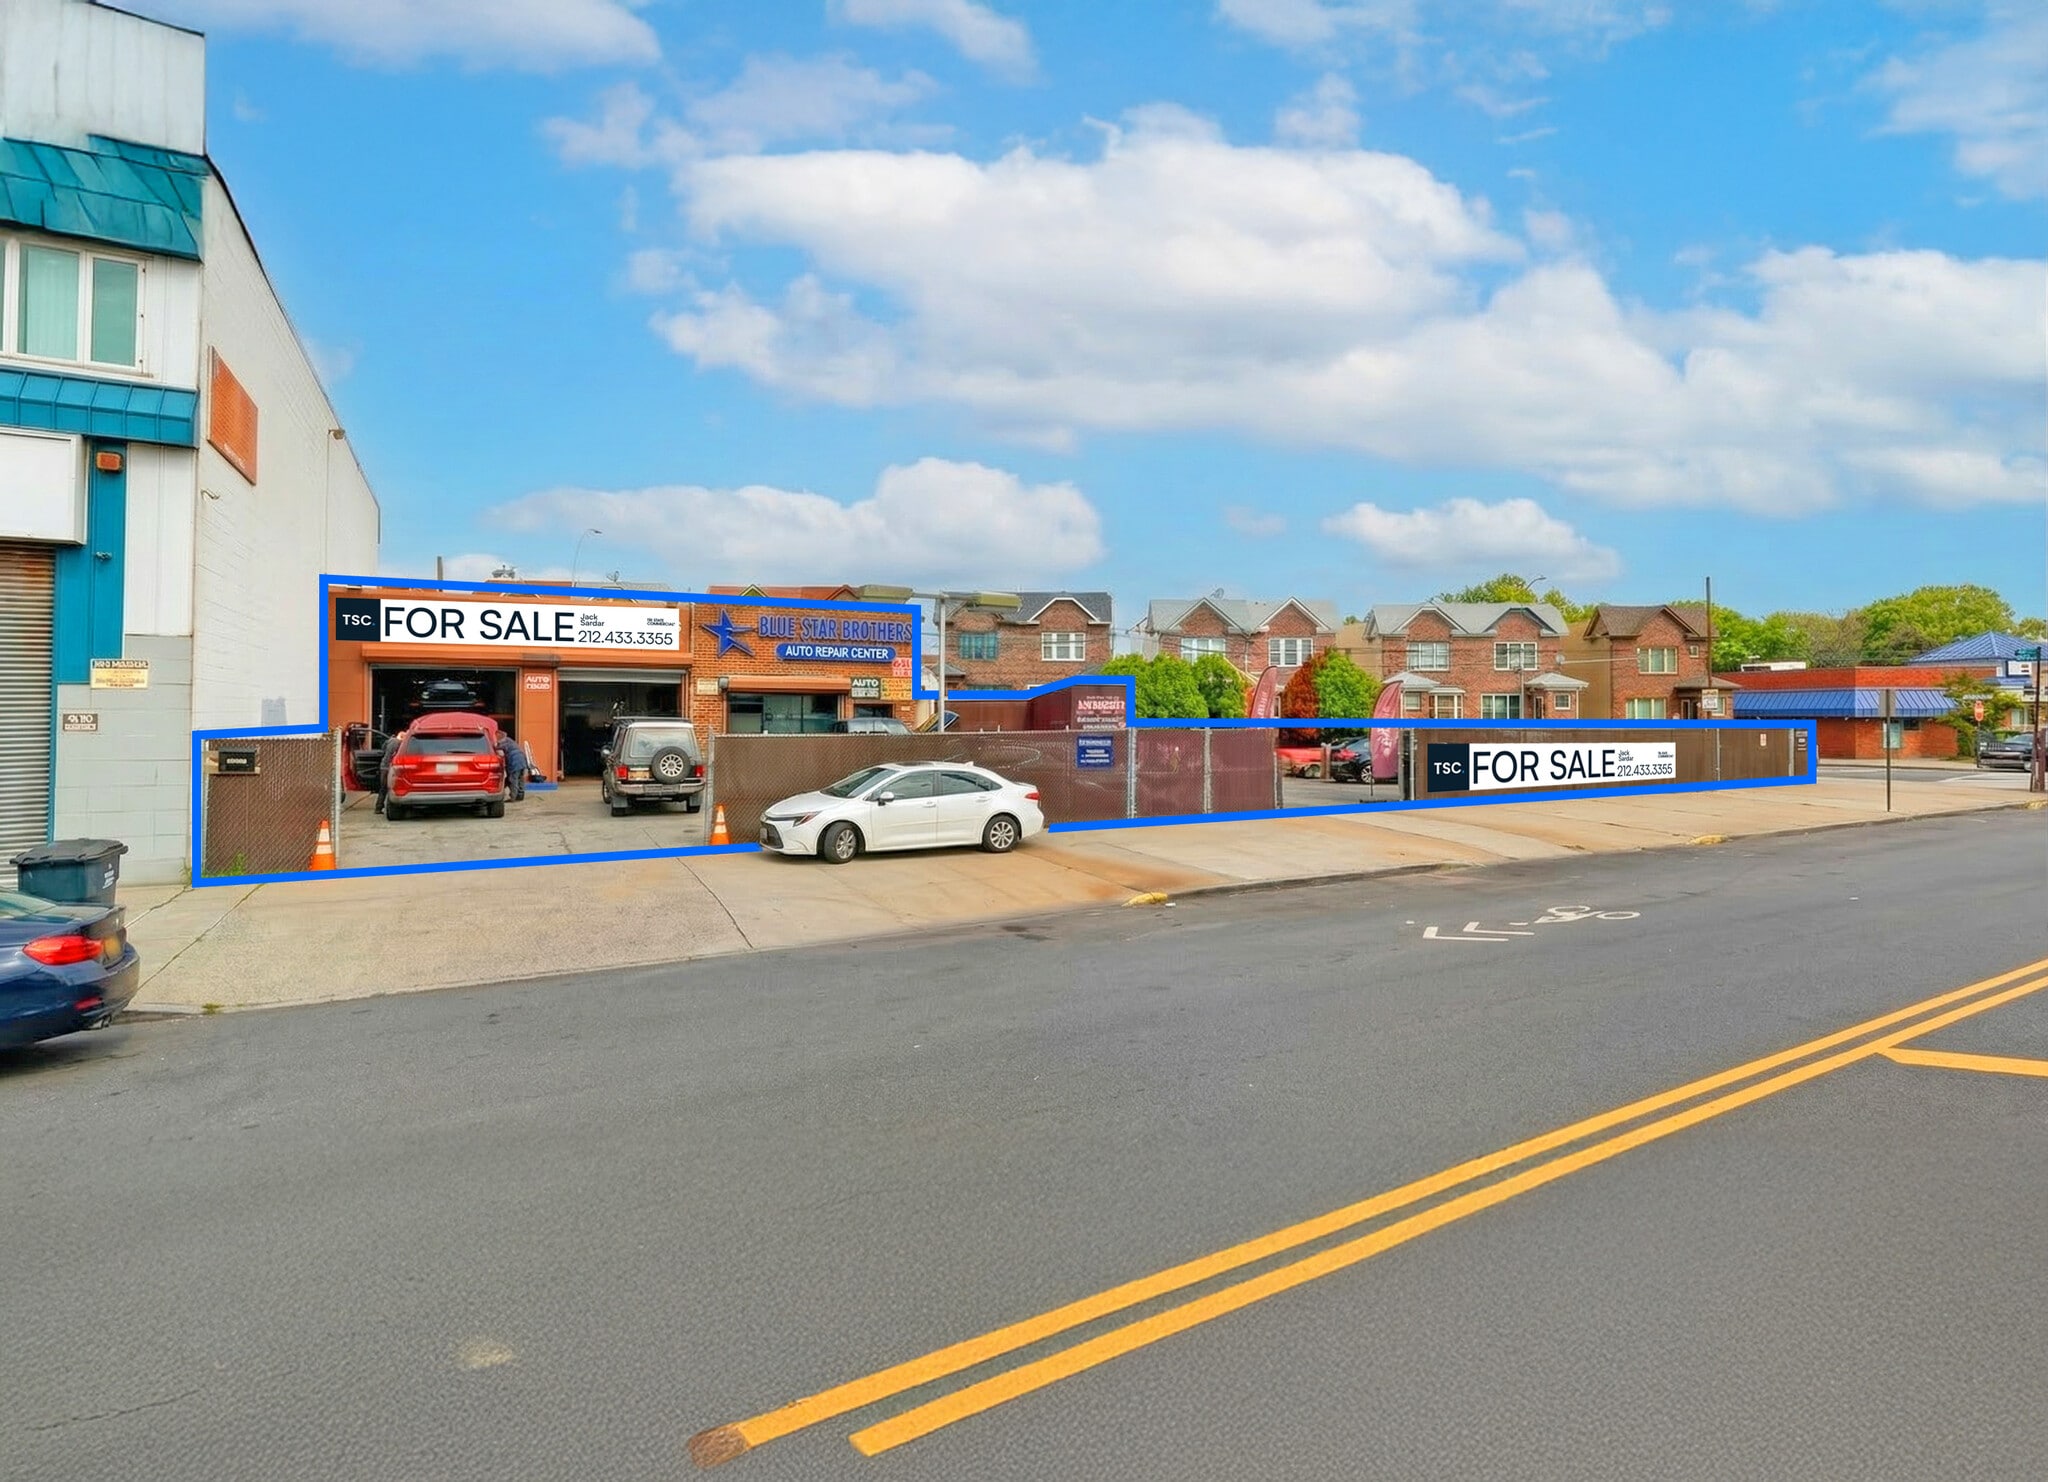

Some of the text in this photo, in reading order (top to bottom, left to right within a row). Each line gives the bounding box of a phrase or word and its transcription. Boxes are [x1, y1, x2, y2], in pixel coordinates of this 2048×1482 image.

[384, 606, 575, 642] FOR SALE
[758, 615, 912, 643] BLUE STAR BROTHERS
[578, 630, 673, 645] 212.433.3355
[785, 644, 889, 659] AUTO REPAIR CENTER
[852, 679, 879, 687] AUTO
[1473, 749, 1616, 784] FOR SALE
[1617, 763, 1673, 777] 212.433.3355
